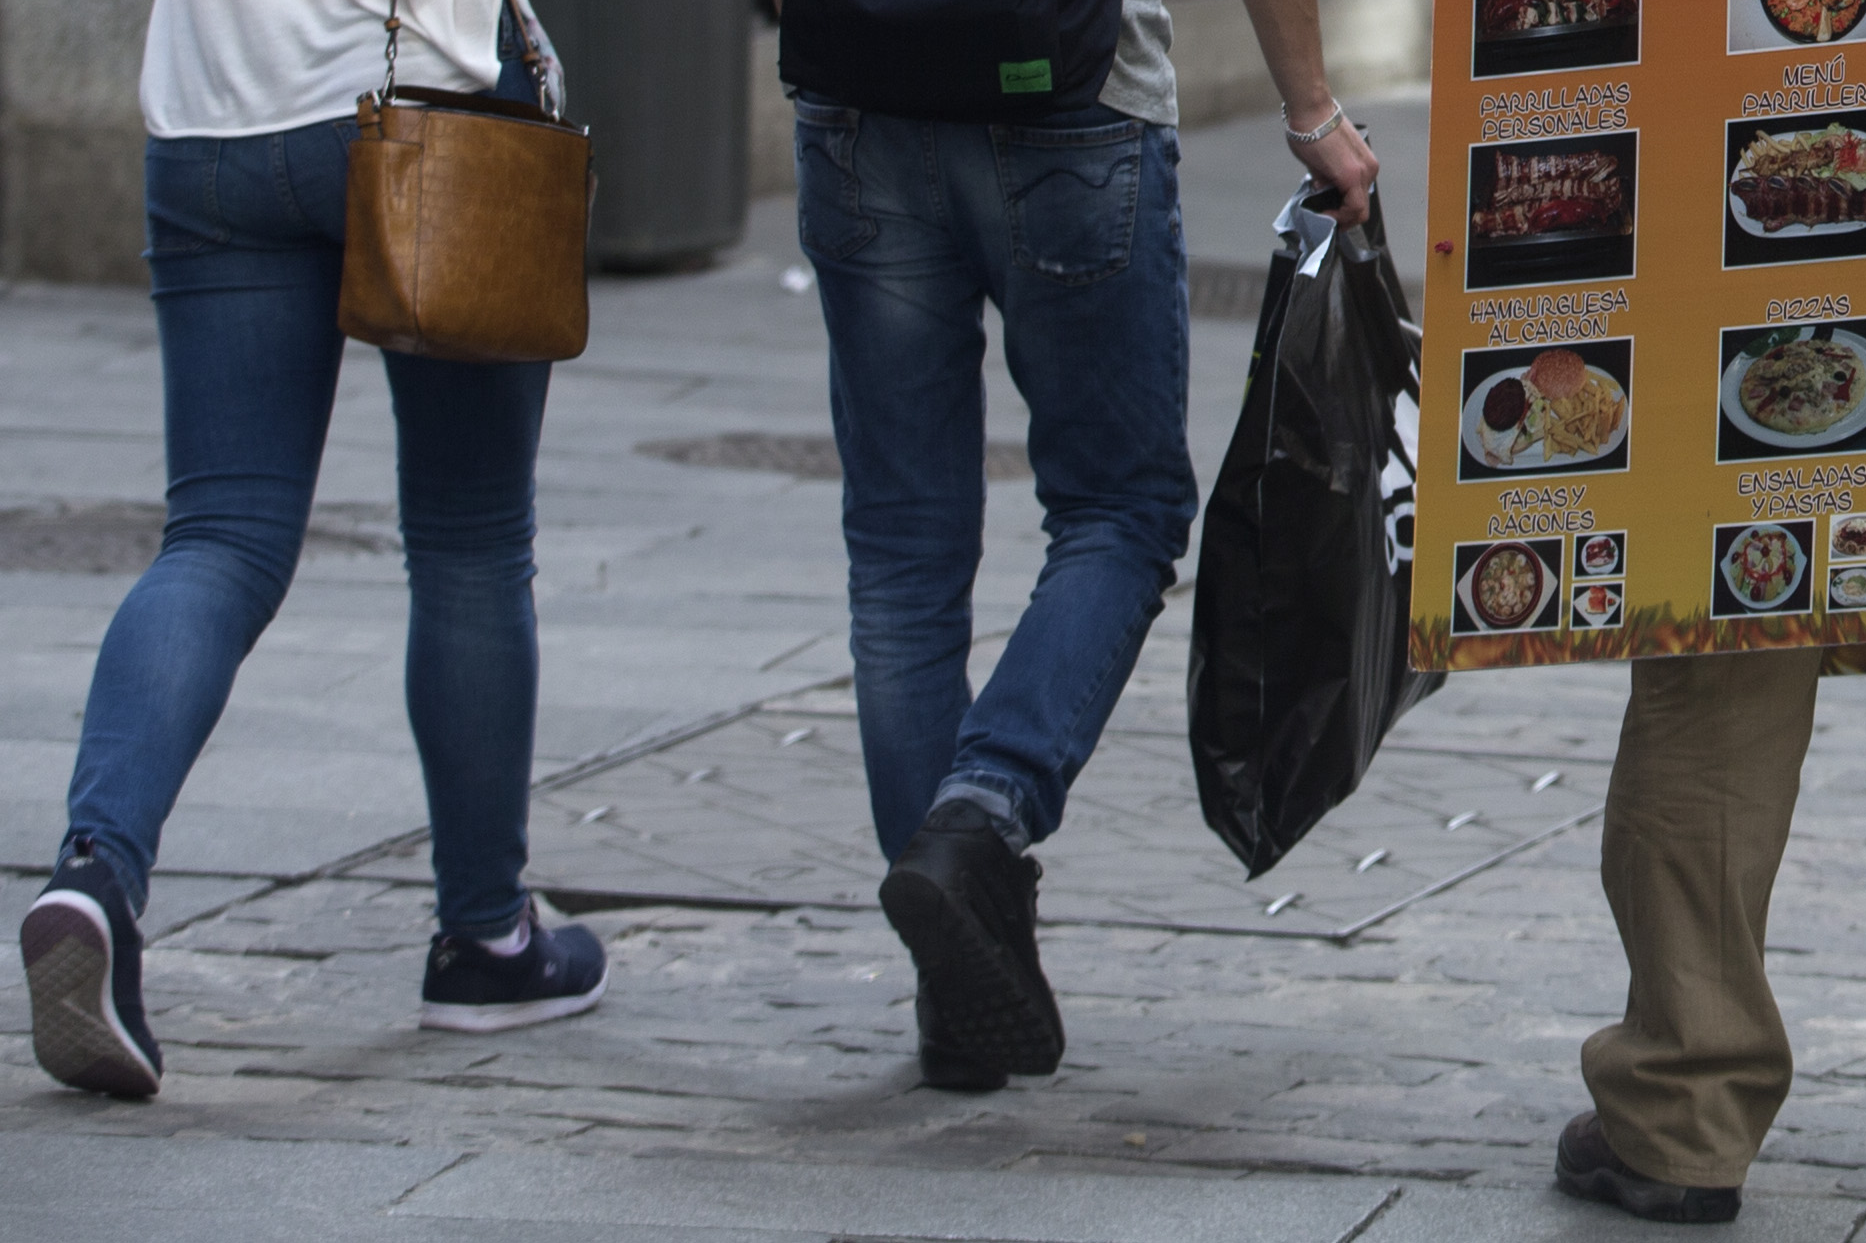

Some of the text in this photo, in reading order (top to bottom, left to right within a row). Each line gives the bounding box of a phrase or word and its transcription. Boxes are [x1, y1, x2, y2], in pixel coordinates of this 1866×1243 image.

[1783, 54, 1845, 89] MENÚ
[1480, 83, 1631, 117] PARRILLADAS
[1482, 108, 1628, 141] PERSONALES
[1469, 288, 1630, 323] HAMBURGUESA
[1766, 295, 1851, 322] PIZZAS
[1518, 311, 1608, 343] CARBÓN
[1766, 491, 1853, 516] PASTAS
[1487, 509, 1595, 537] RACIONES
